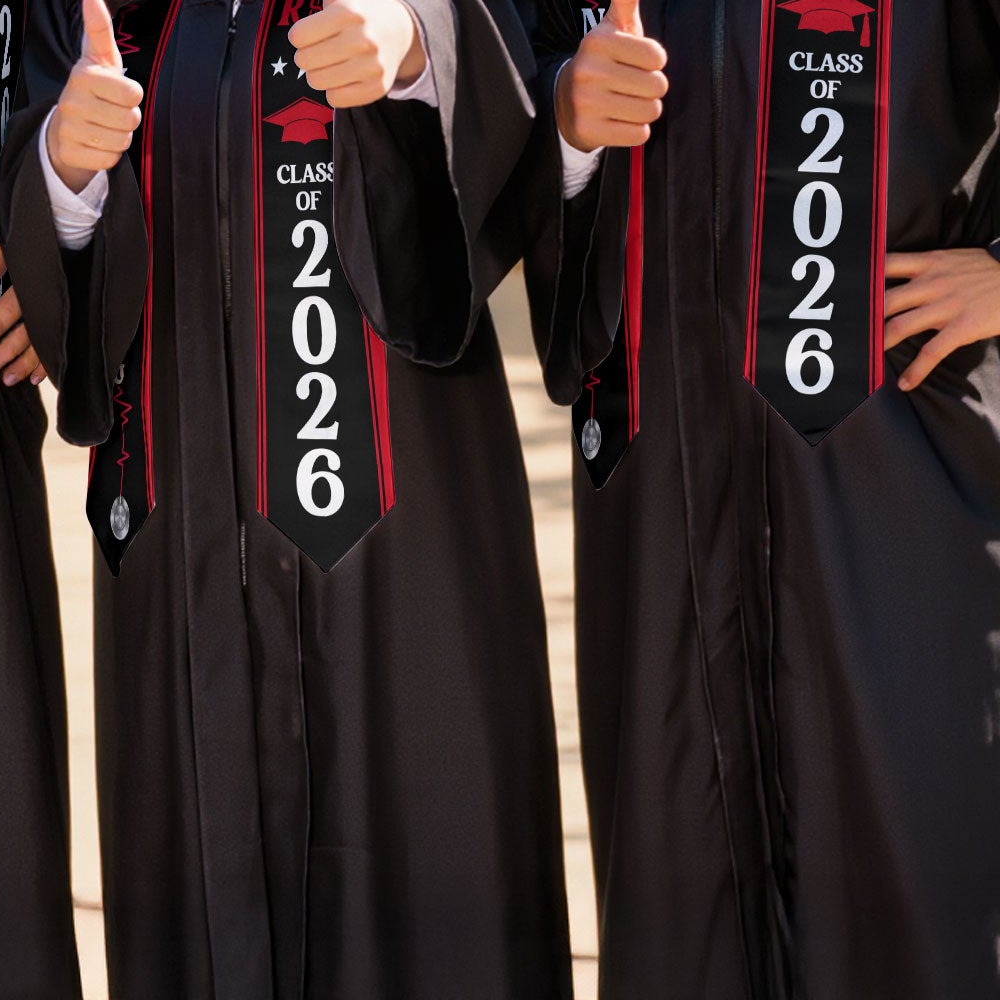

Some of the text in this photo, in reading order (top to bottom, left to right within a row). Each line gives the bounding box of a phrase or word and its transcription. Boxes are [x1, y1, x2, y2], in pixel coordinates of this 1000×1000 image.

[788, 51, 864, 74] CLASS
[809, 79, 842, 99] OF
[276, 161, 335, 185] CLASS
[295, 190, 322, 211] OF
[784, 107, 845, 395] 2026
[291, 219, 345, 517] 2026
